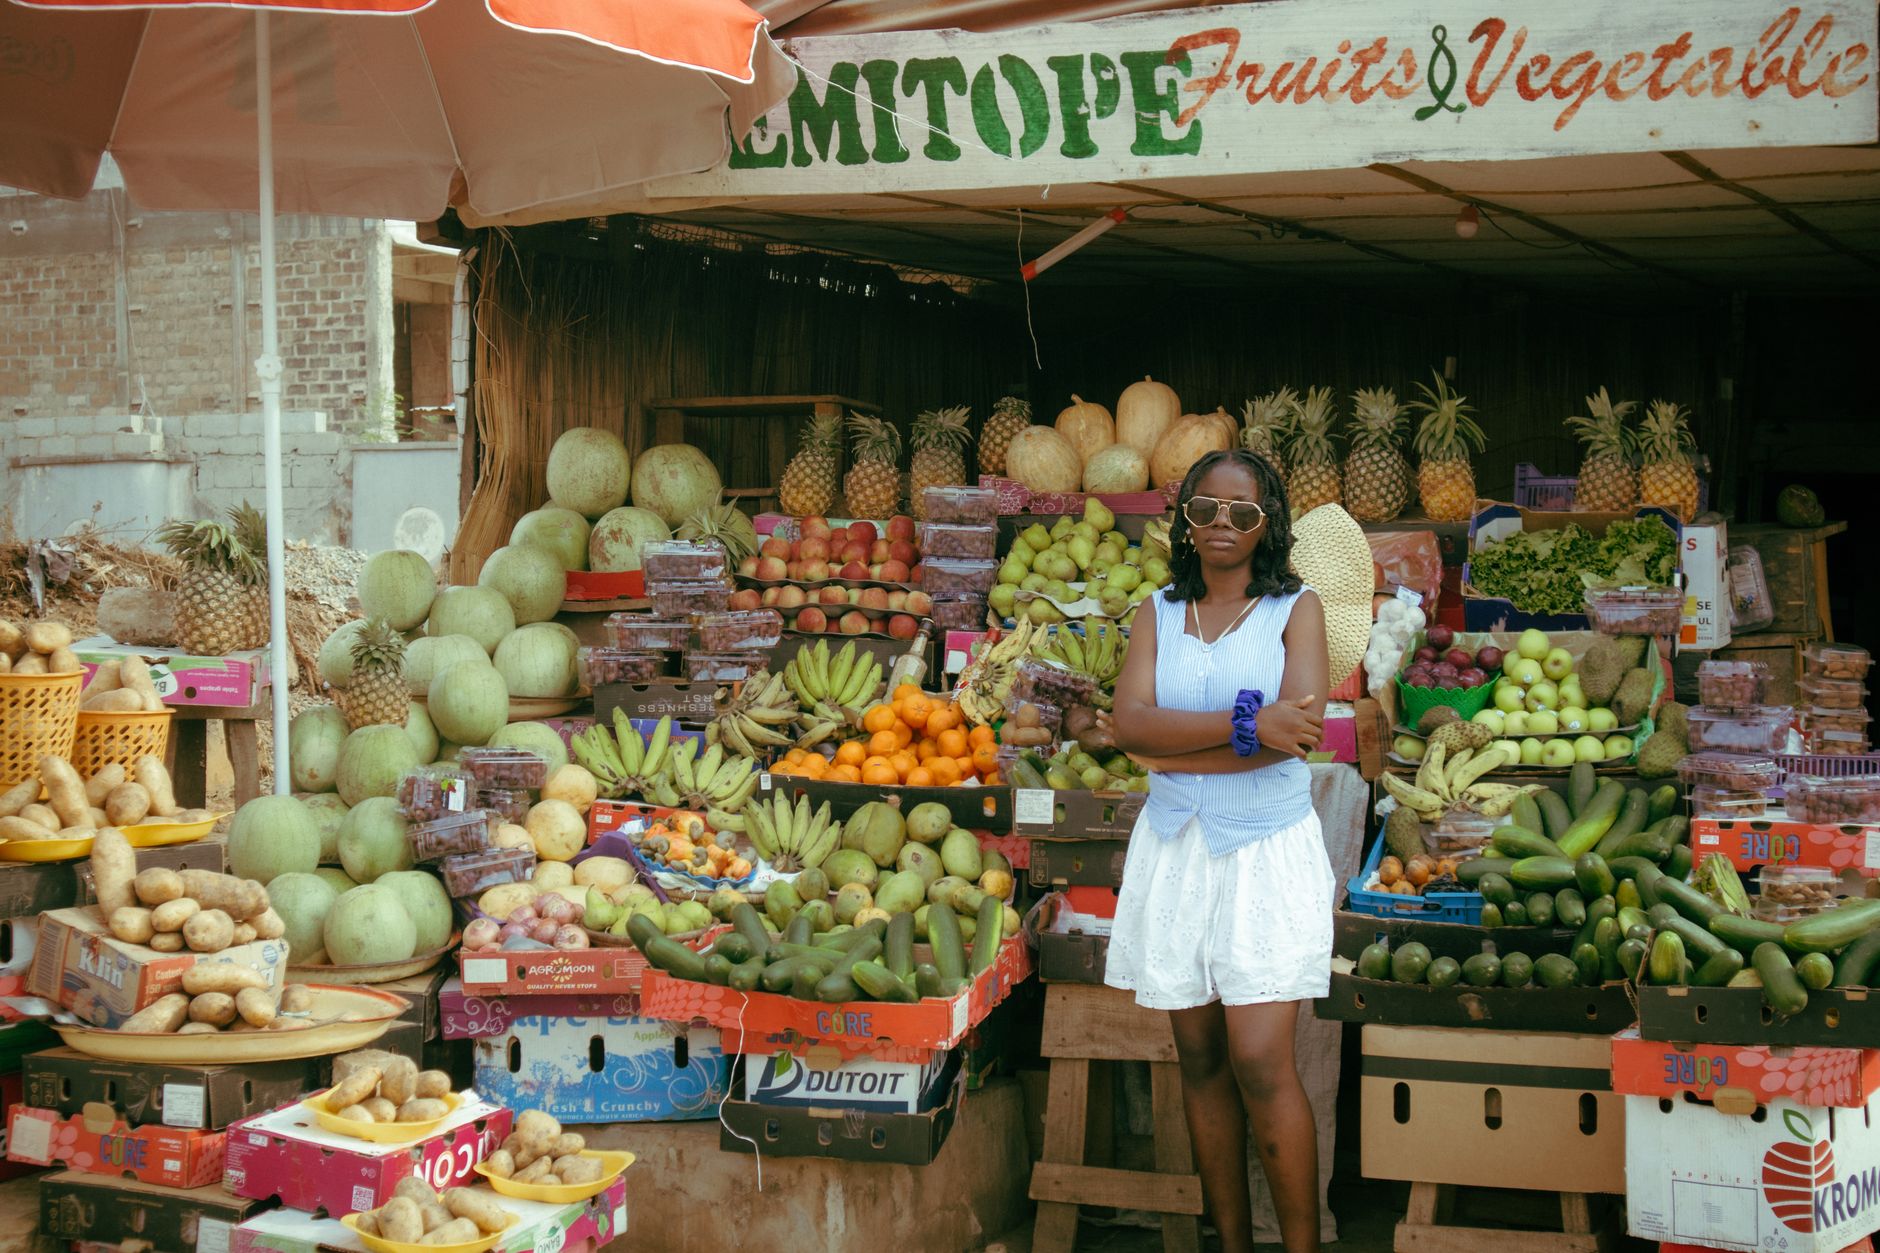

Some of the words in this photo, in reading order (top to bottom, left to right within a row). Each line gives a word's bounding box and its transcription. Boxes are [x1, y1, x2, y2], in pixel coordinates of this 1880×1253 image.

[1164, 27, 1423, 128] Fruits
[1414, 24, 1467, 121] &
[1467, 7, 1870, 131] Vegetable
[637, 703, 715, 713] RESHNESS
[683, 694, 712, 703] RST
[1740, 832, 1801, 863] CORE
[79, 946, 123, 990] Klin
[633, 1031, 671, 1042] Apples
[817, 1007, 873, 1037] CORE
[805, 1070, 905, 1095] DUTOIT
[1664, 1054, 1728, 1088] CORE
[601, 1100, 661, 1113] Crunchy
[100, 1130, 149, 1169] CORE
[1671, 1170, 1758, 1185] APPLES
[1814, 1166, 1880, 1232] KROM
